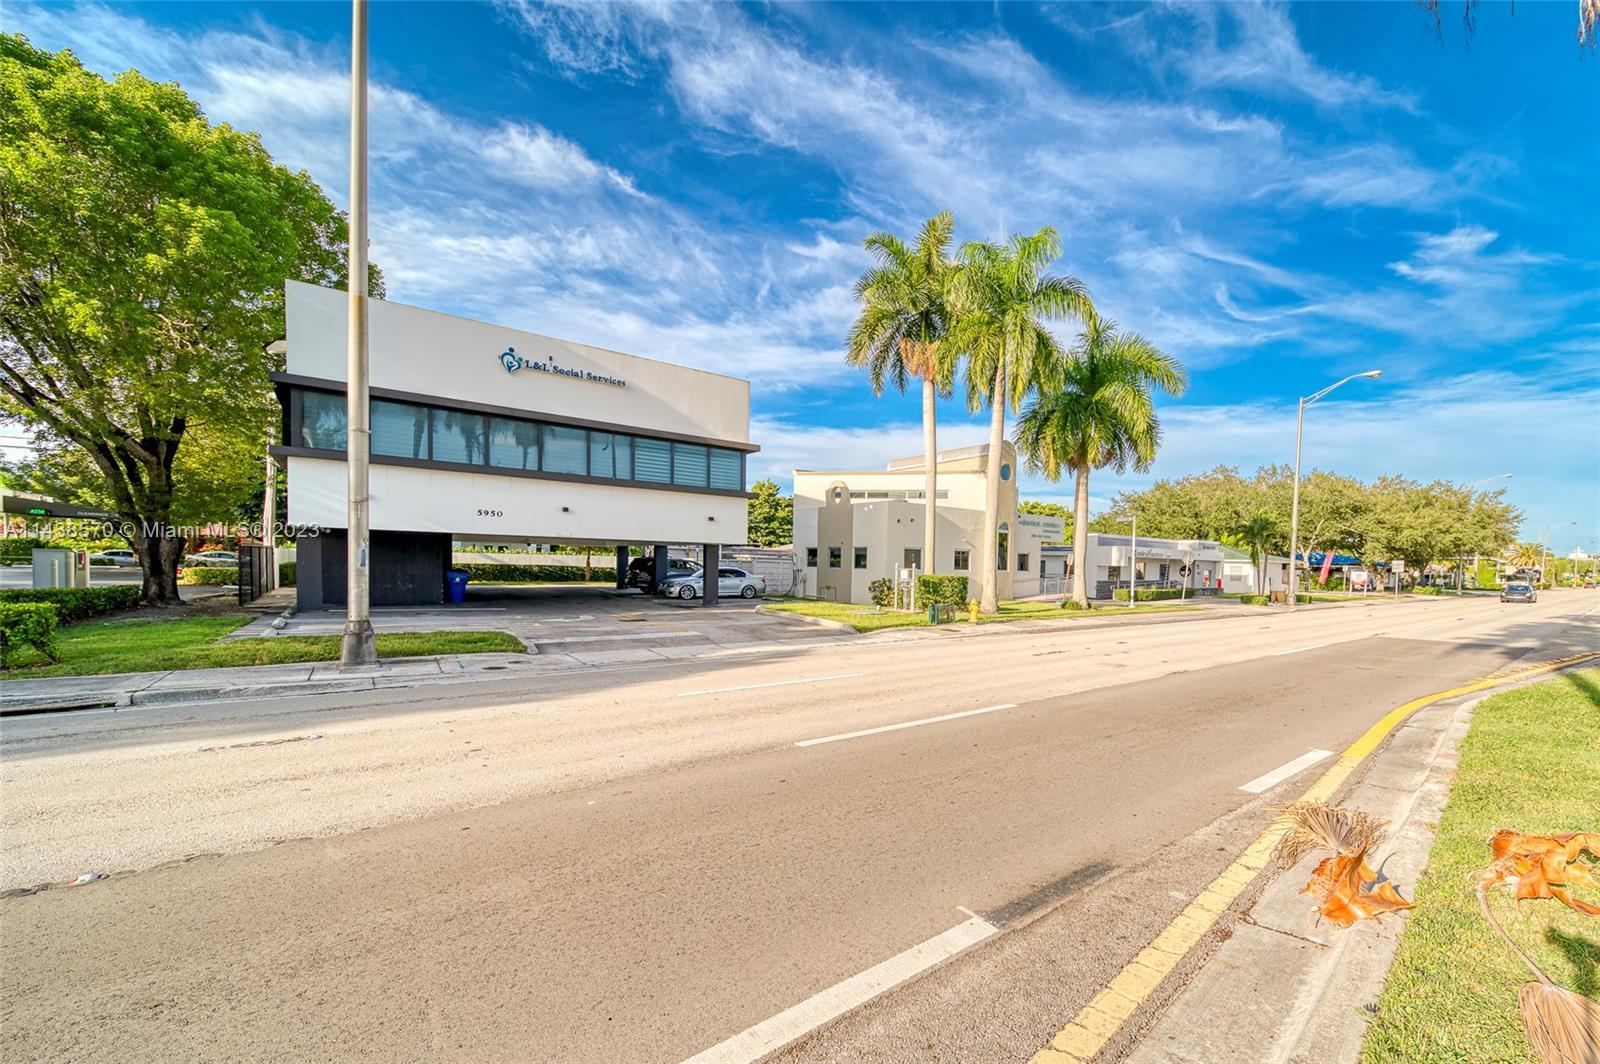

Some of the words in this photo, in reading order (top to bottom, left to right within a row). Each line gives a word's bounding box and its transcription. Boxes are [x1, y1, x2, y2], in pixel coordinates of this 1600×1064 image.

[525, 359, 550, 373] L&L
[552, 365, 584, 379] Social
[586, 372, 626, 387] Services
[477, 509, 503, 517] 5950
